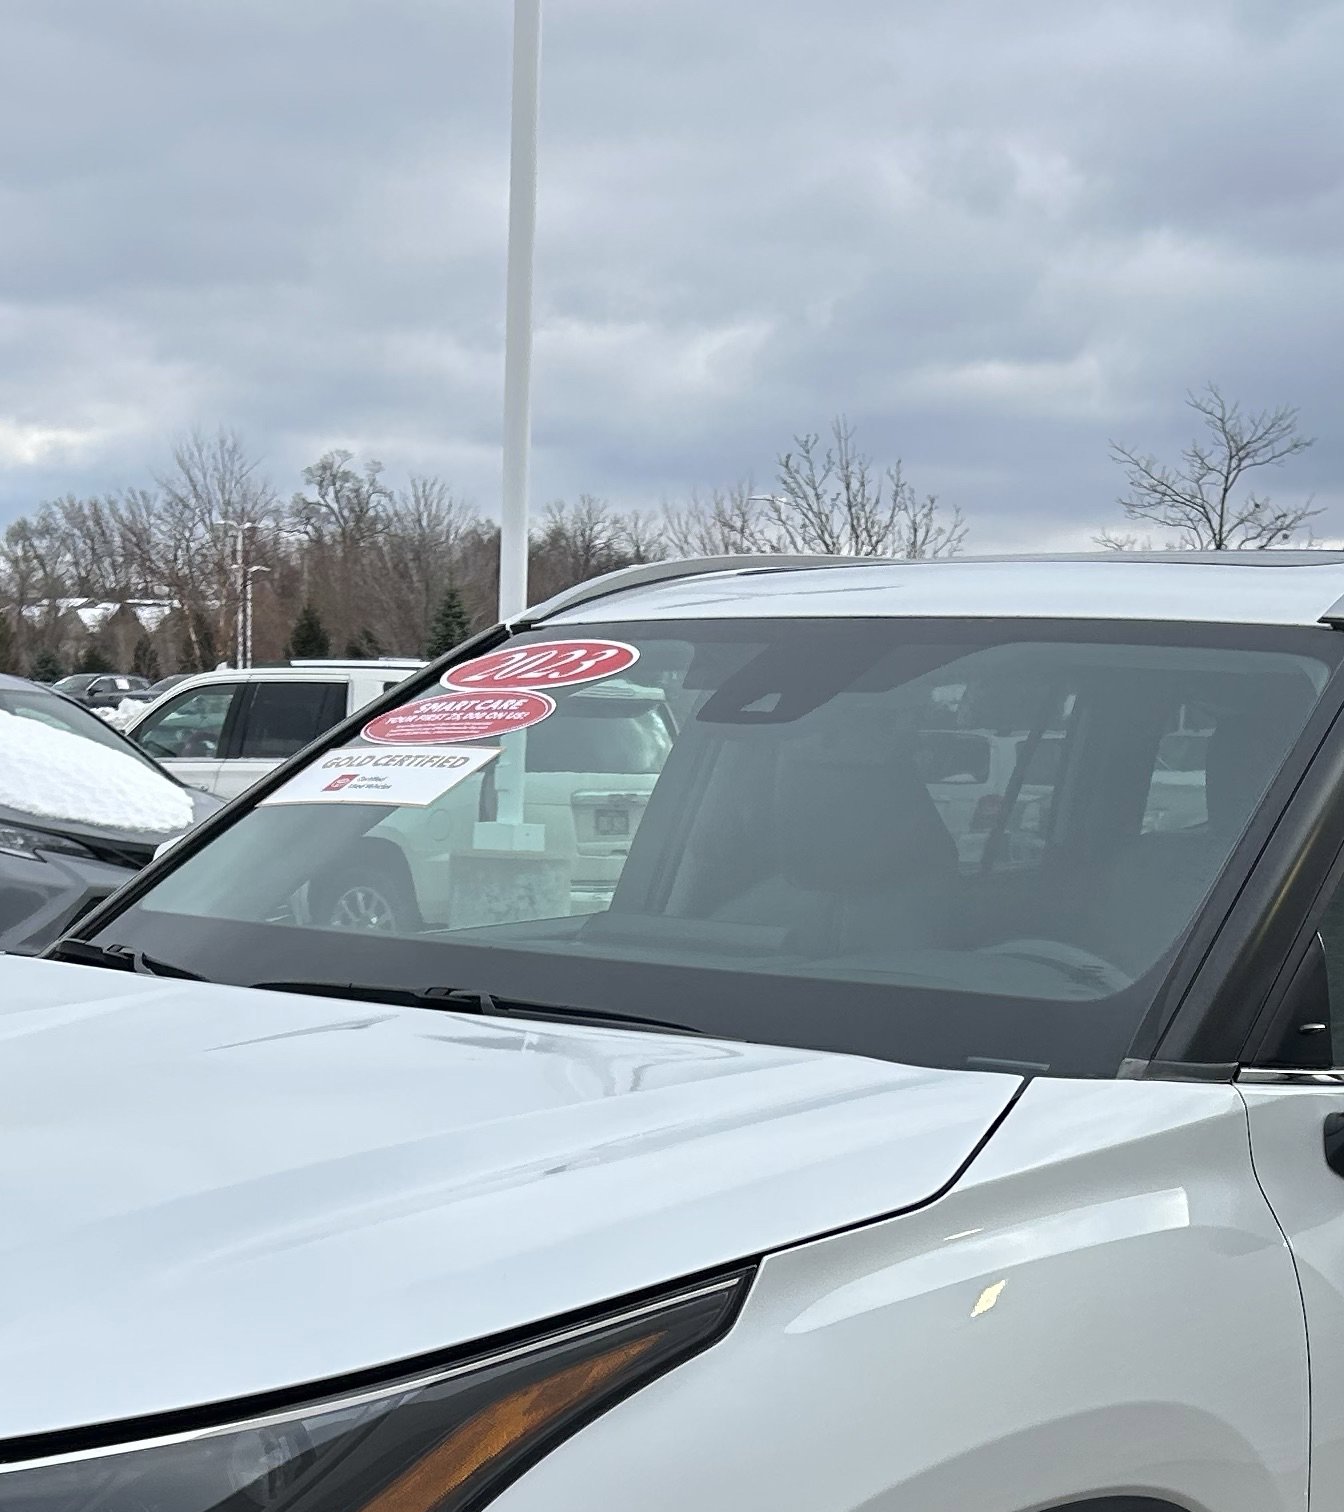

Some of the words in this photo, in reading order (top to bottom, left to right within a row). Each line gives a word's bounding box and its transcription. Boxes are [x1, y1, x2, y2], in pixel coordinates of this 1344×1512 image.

[459, 649, 619, 683] 2023
[414, 700, 480, 714] SMART
[474, 699, 529, 711] CARE
[321, 755, 375, 769] GOLD
[372, 754, 471, 769] CERTIFIED
